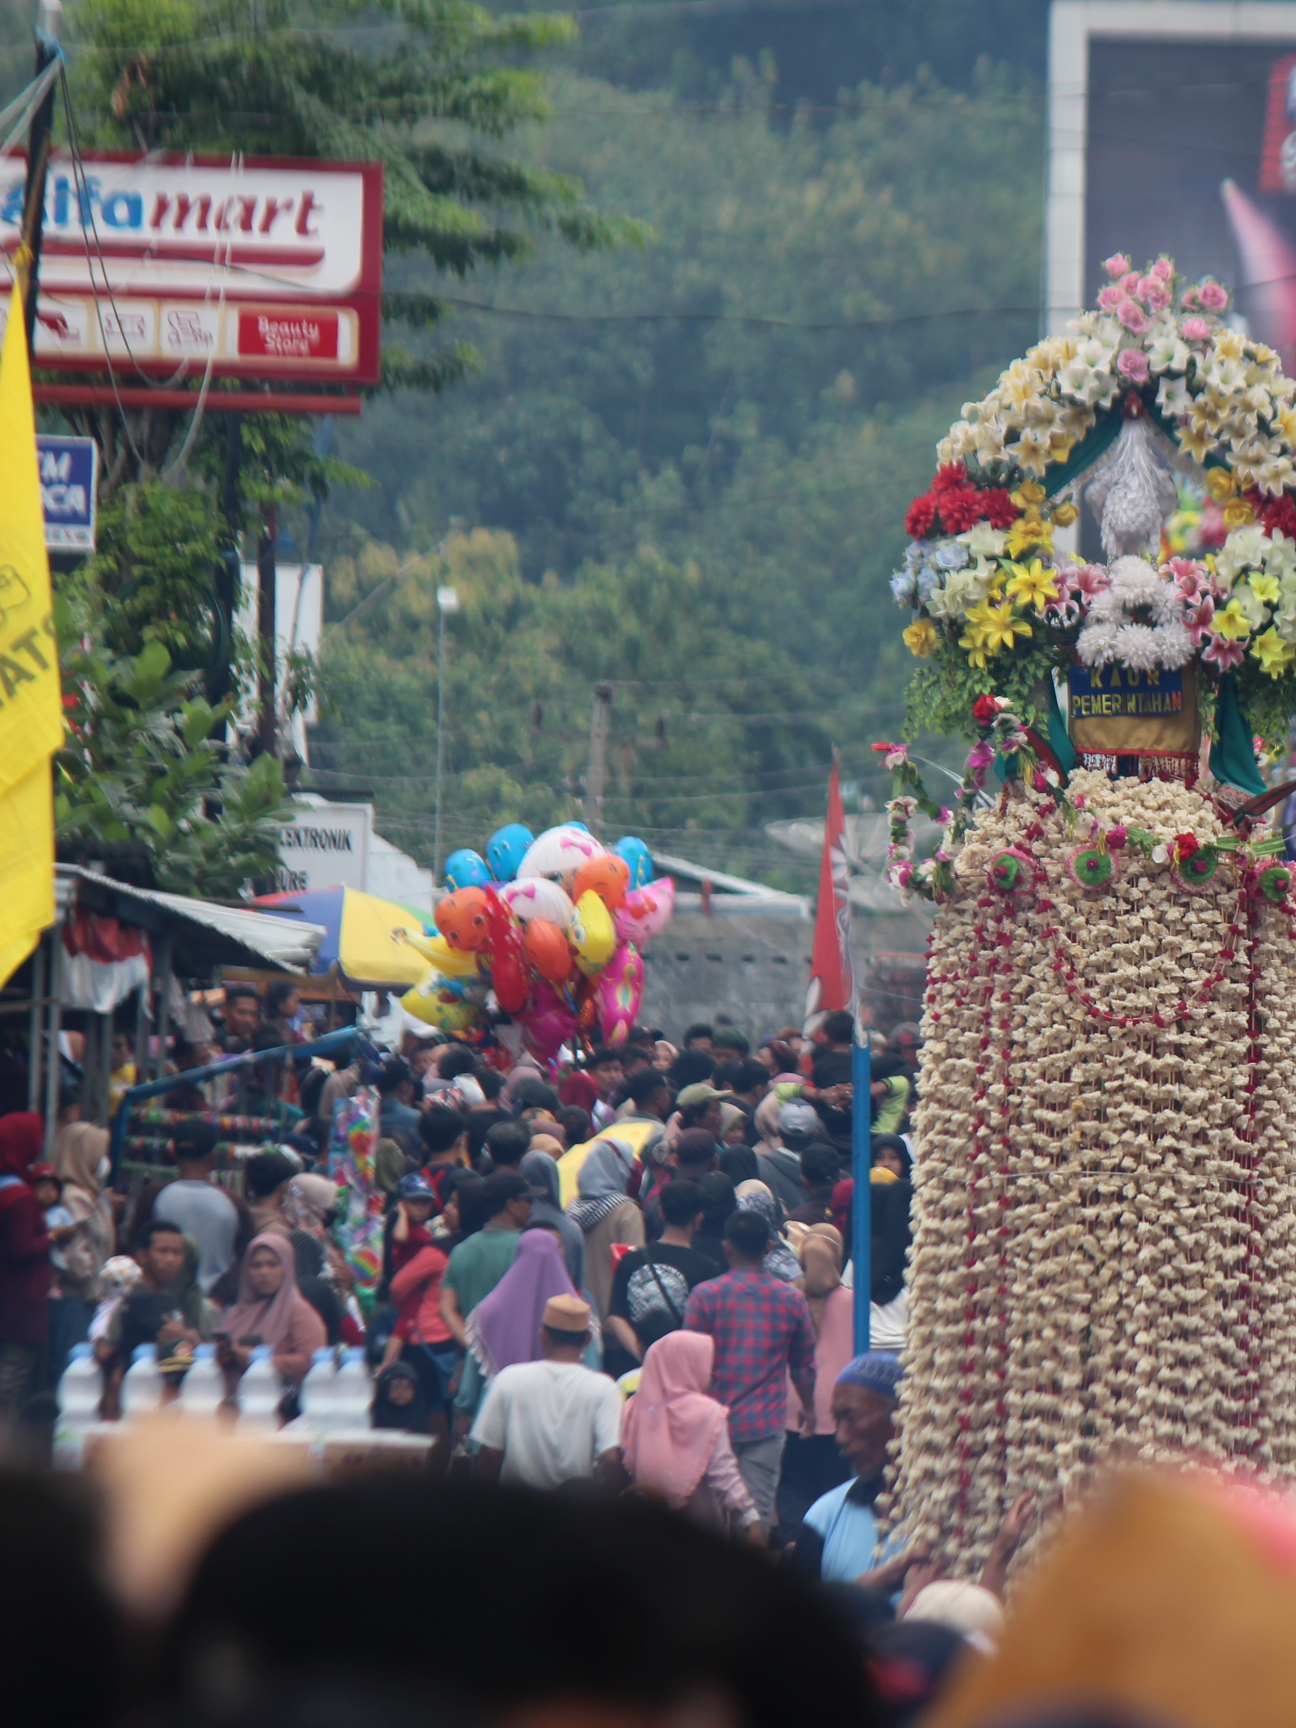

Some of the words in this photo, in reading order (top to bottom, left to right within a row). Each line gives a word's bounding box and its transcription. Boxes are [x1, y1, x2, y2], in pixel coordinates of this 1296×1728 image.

[257, 316, 319, 344] Beauty
[264, 333, 310, 354] Store
[1071, 691, 1182, 716] PEMERINTAHAN
